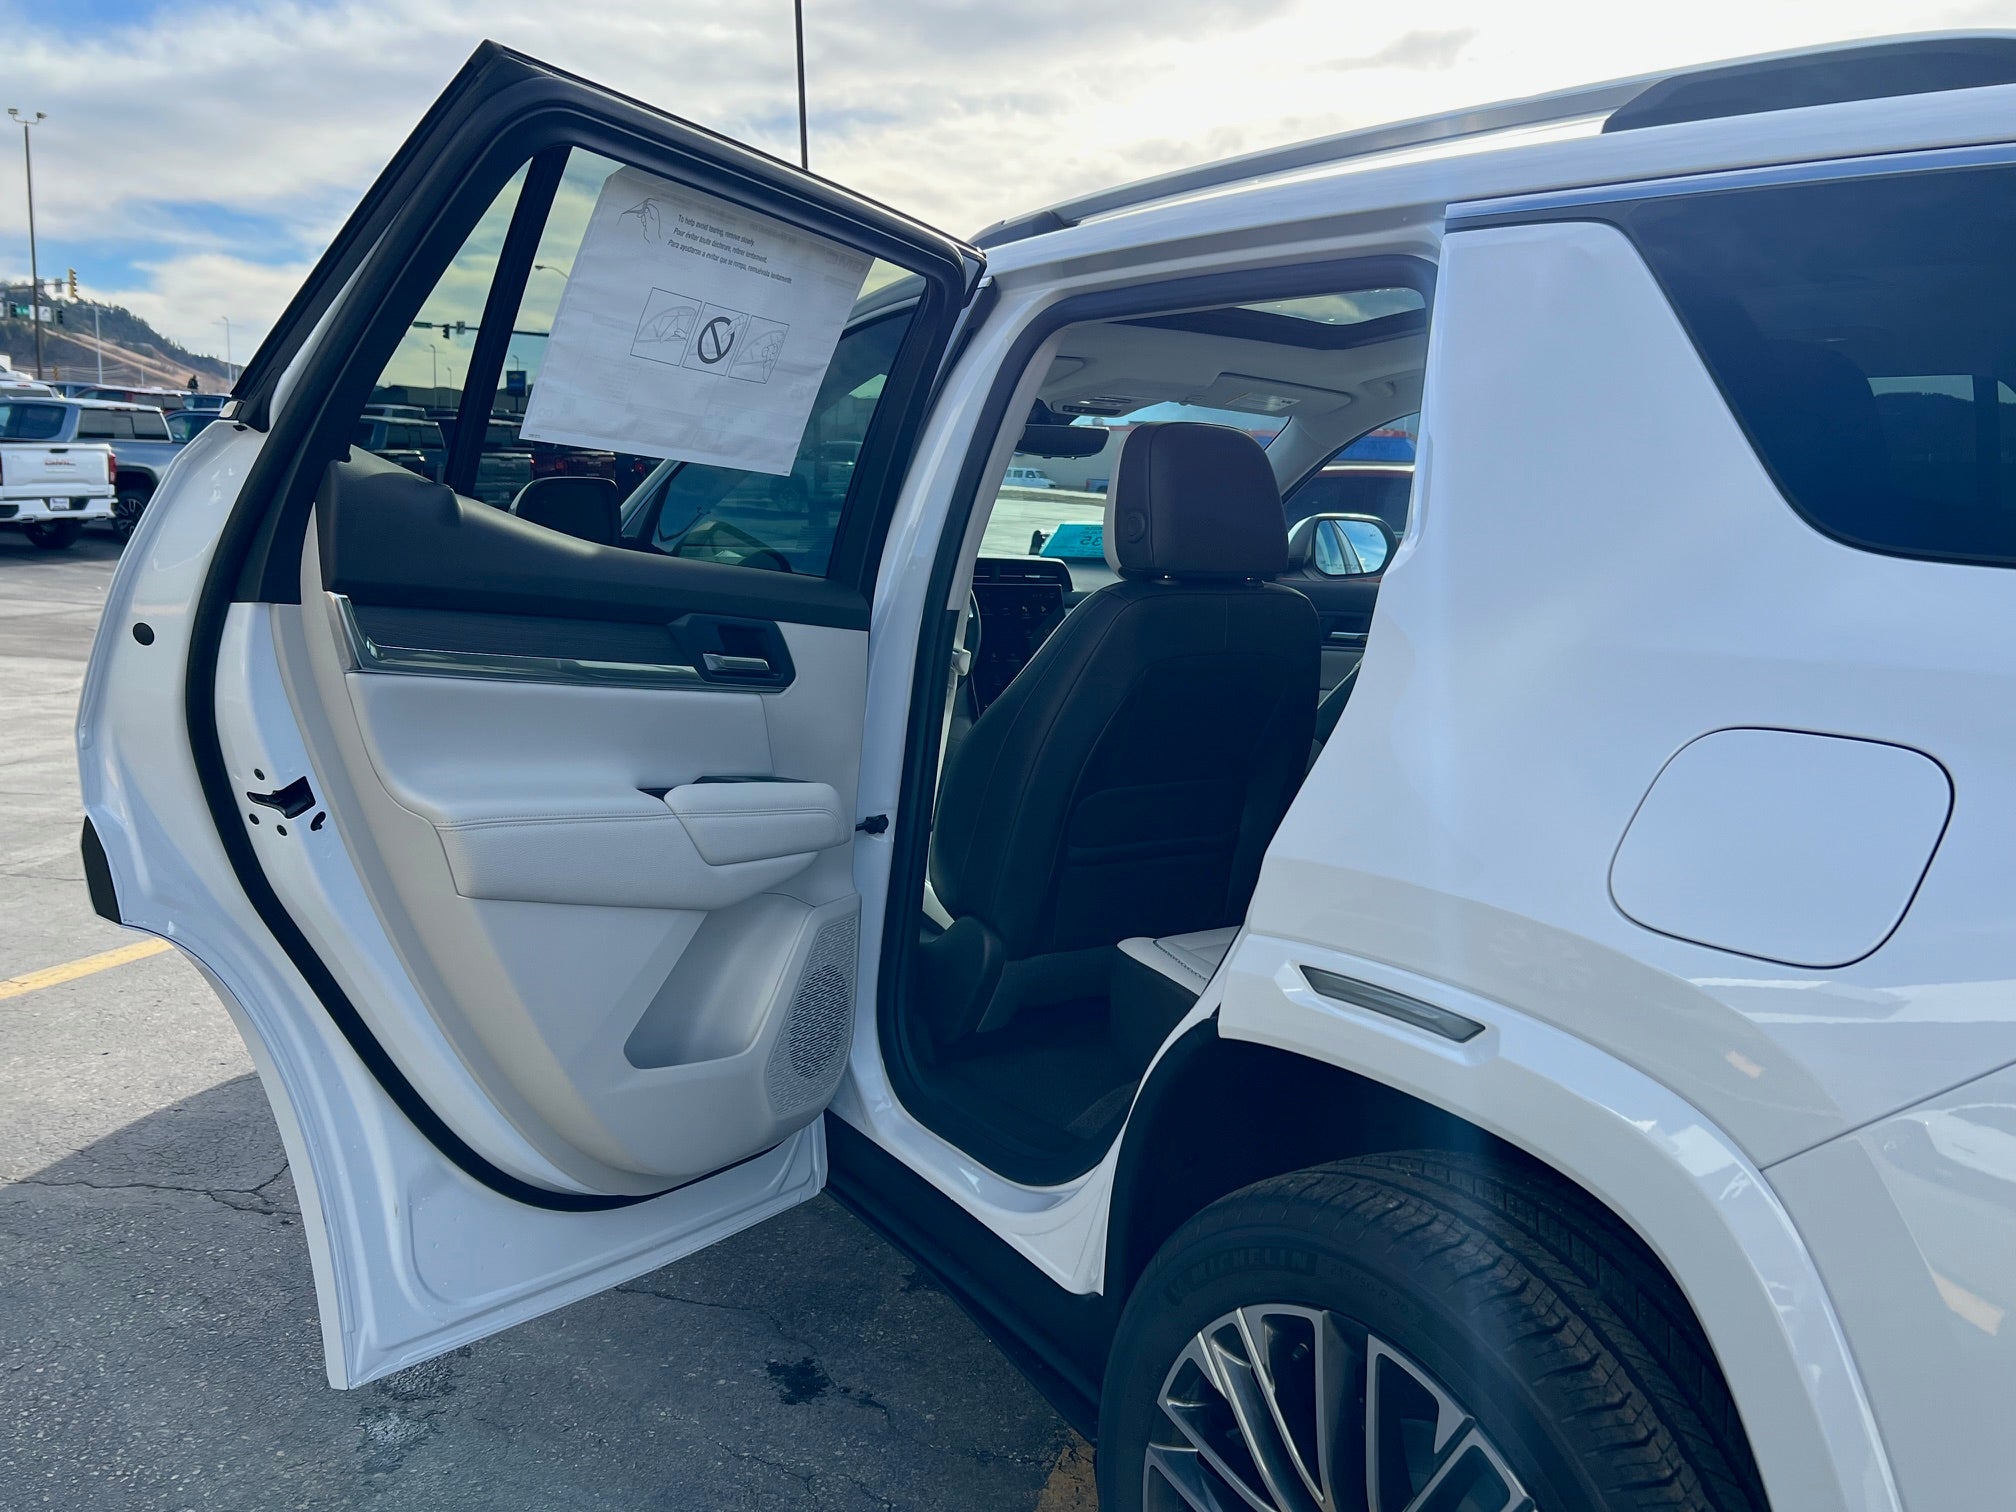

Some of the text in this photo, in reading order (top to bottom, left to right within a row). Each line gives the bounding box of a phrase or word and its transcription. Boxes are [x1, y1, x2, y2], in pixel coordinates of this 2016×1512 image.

[678, 214, 685, 223] To
[685, 216, 695, 227] help
[696, 220, 708, 231] avoid
[673, 227, 686, 237] Pour
